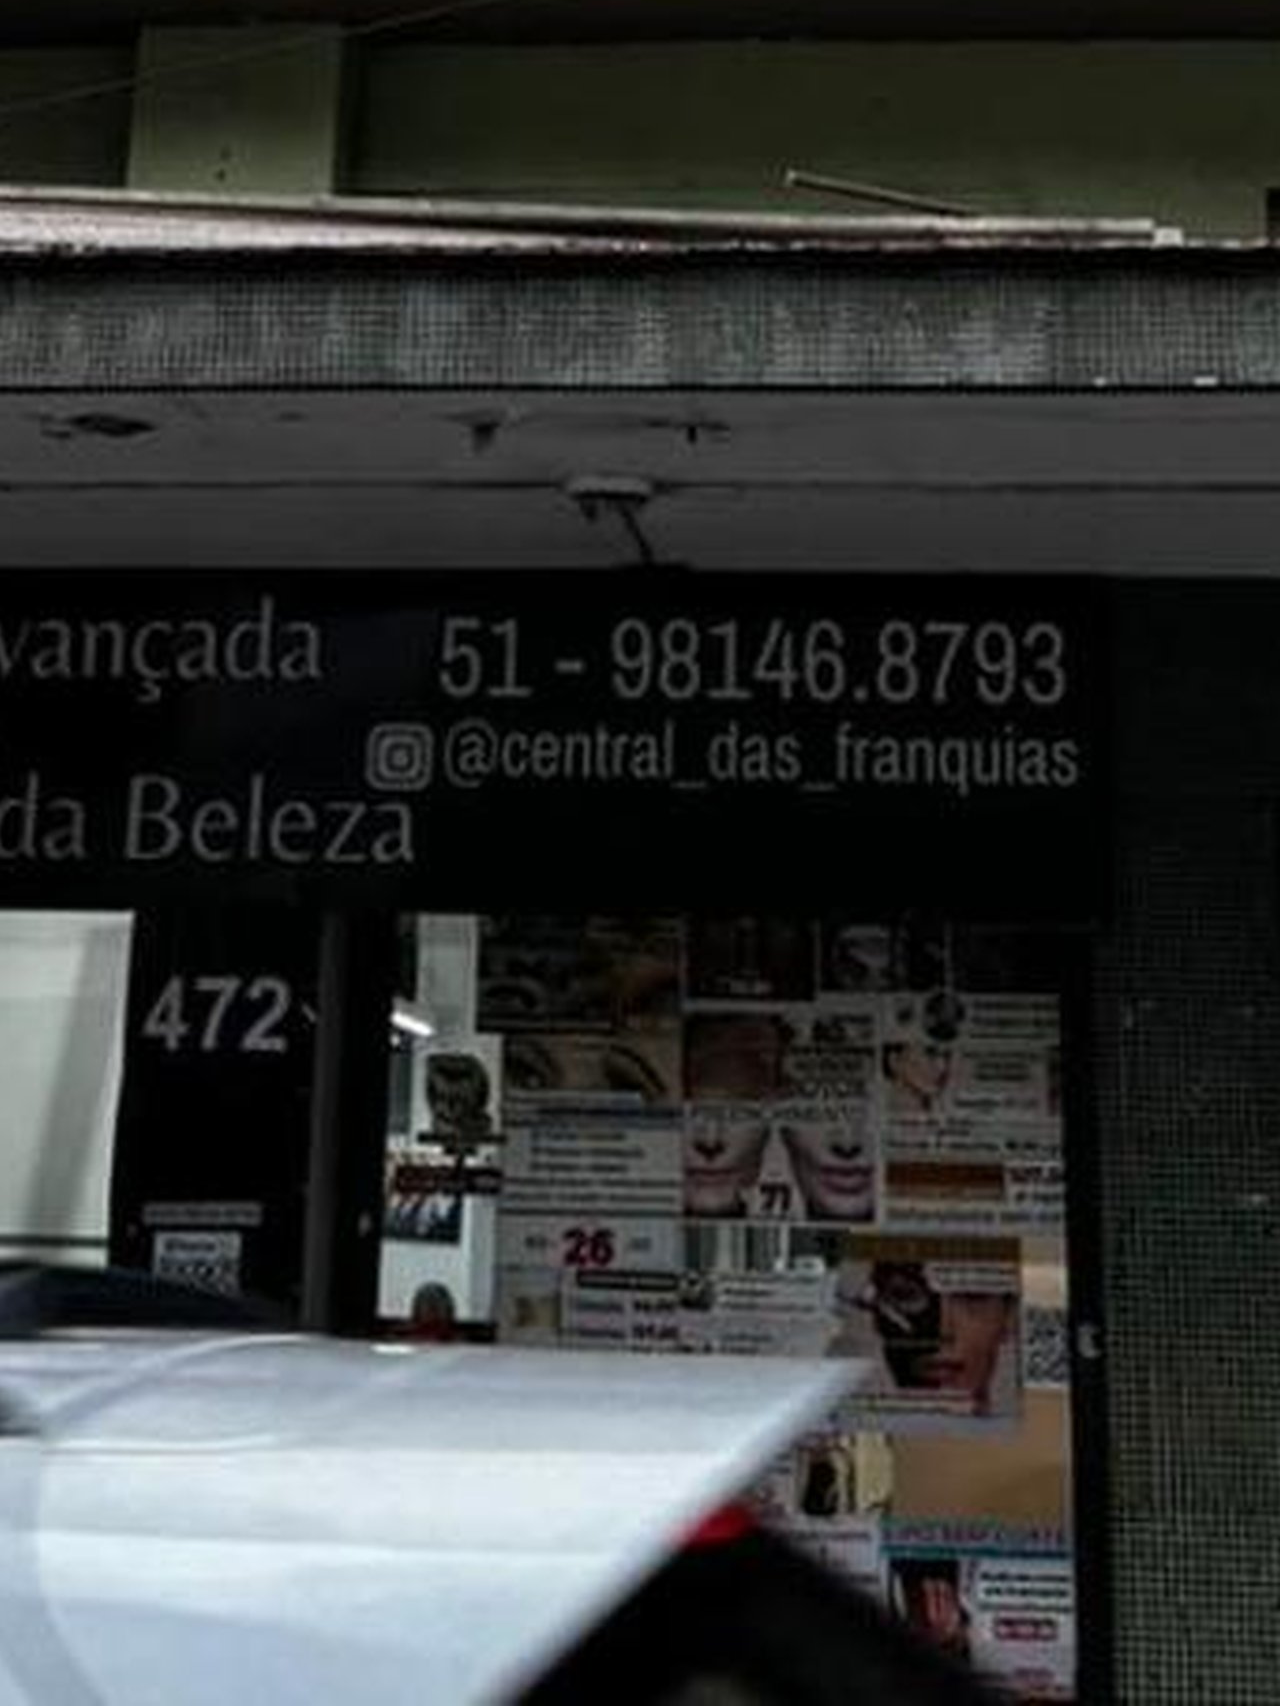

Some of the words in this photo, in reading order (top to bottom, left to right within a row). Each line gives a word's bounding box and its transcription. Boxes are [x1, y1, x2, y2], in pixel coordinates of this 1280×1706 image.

[438, 616, 532, 699] 51
[610, 618, 1067, 705] 98146.8793
[443, 717, 1080, 797] @central_das_franquias
[124, 775, 415, 865] Beleza
[143, 976, 289, 1053] 472
